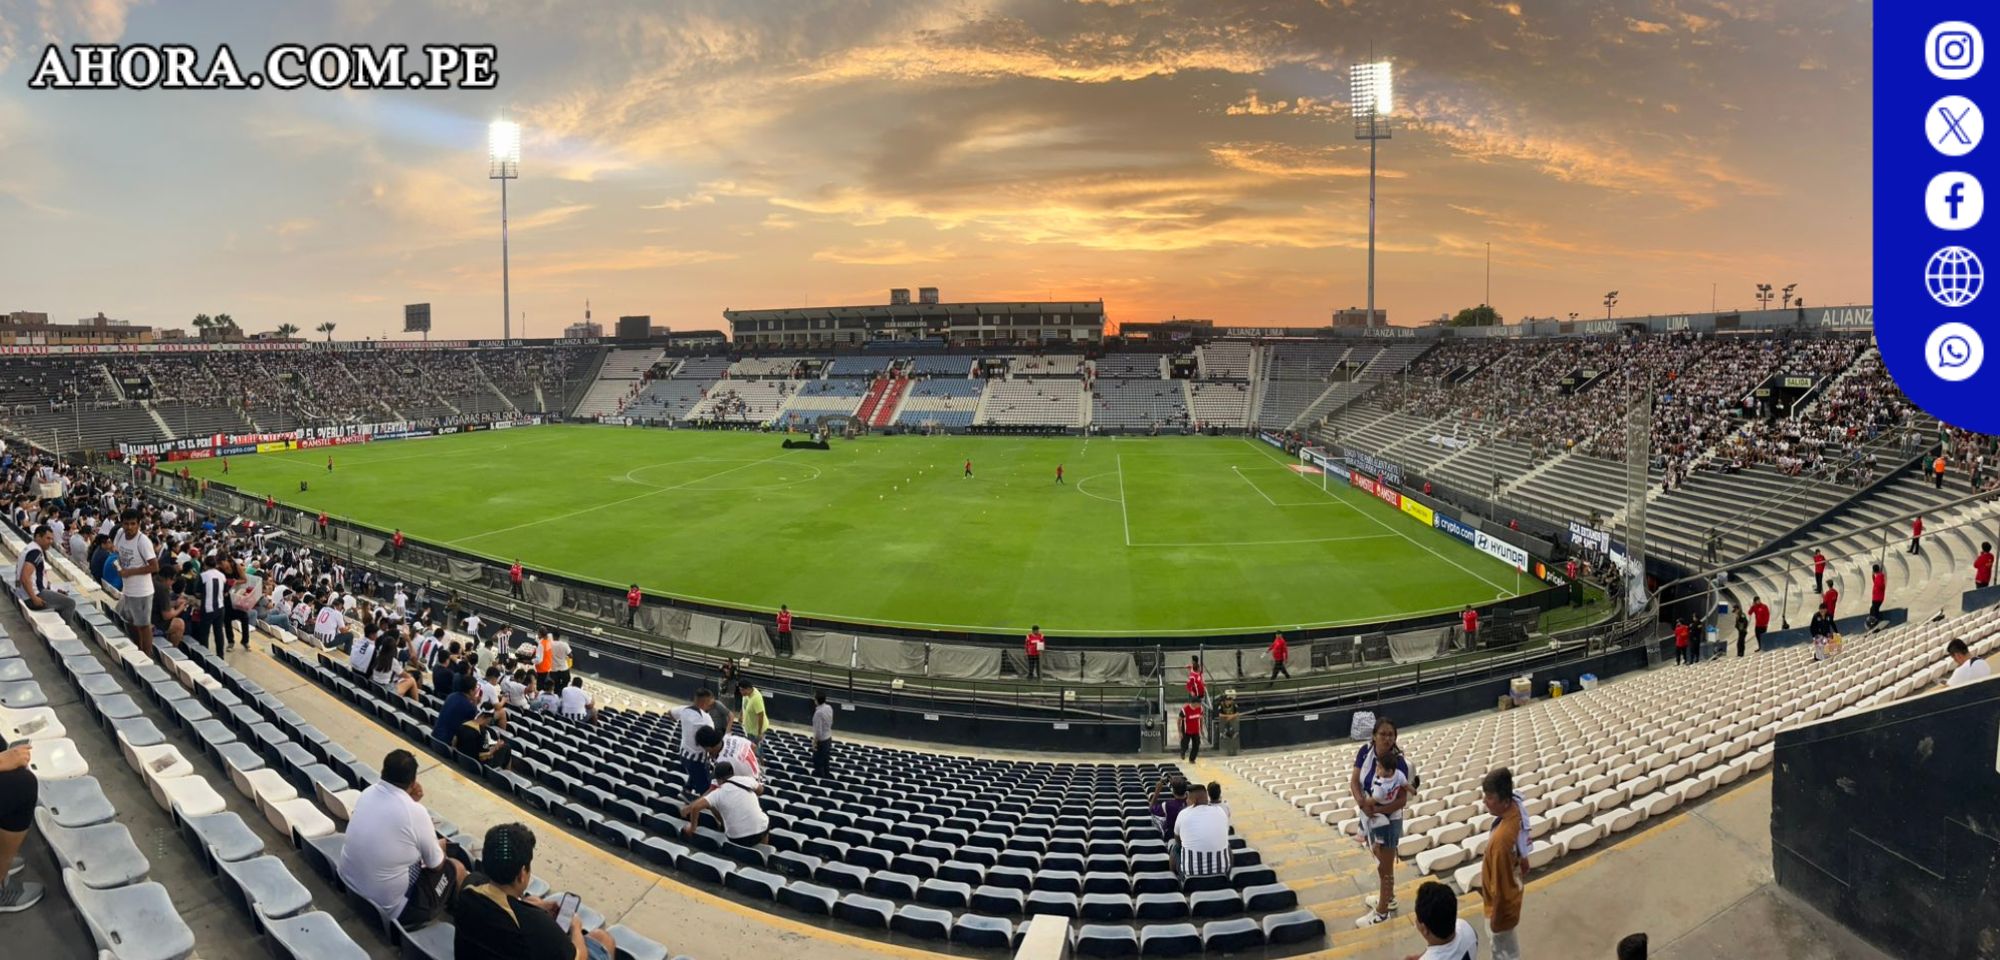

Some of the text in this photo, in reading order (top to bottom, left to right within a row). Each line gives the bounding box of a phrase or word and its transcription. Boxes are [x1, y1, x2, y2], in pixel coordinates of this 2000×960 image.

[1821, 309, 1873, 326] ALIANZ
[1585, 317, 1690, 333] ALIANZA LIMA
[1227, 328, 1285, 337] ALIANZA LIMA
[1363, 328, 1415, 337] ALIANZA LIMA
[478, 340, 505, 348] ALIANZA
[554, 338, 582, 346] ALIANZA
[1786, 378, 1809, 387] SALIDA
[223, 446, 256, 455] crypto.com
[1359, 475, 1374, 493] AMSTEL
[1381, 486, 1397, 506] AMSTEL
[1441, 519, 1475, 543] crypto.com
[1491, 541, 1526, 569] HYUNDAI
[318, 611, 329, 624] 10
[434, 873, 449, 897] NIKE
